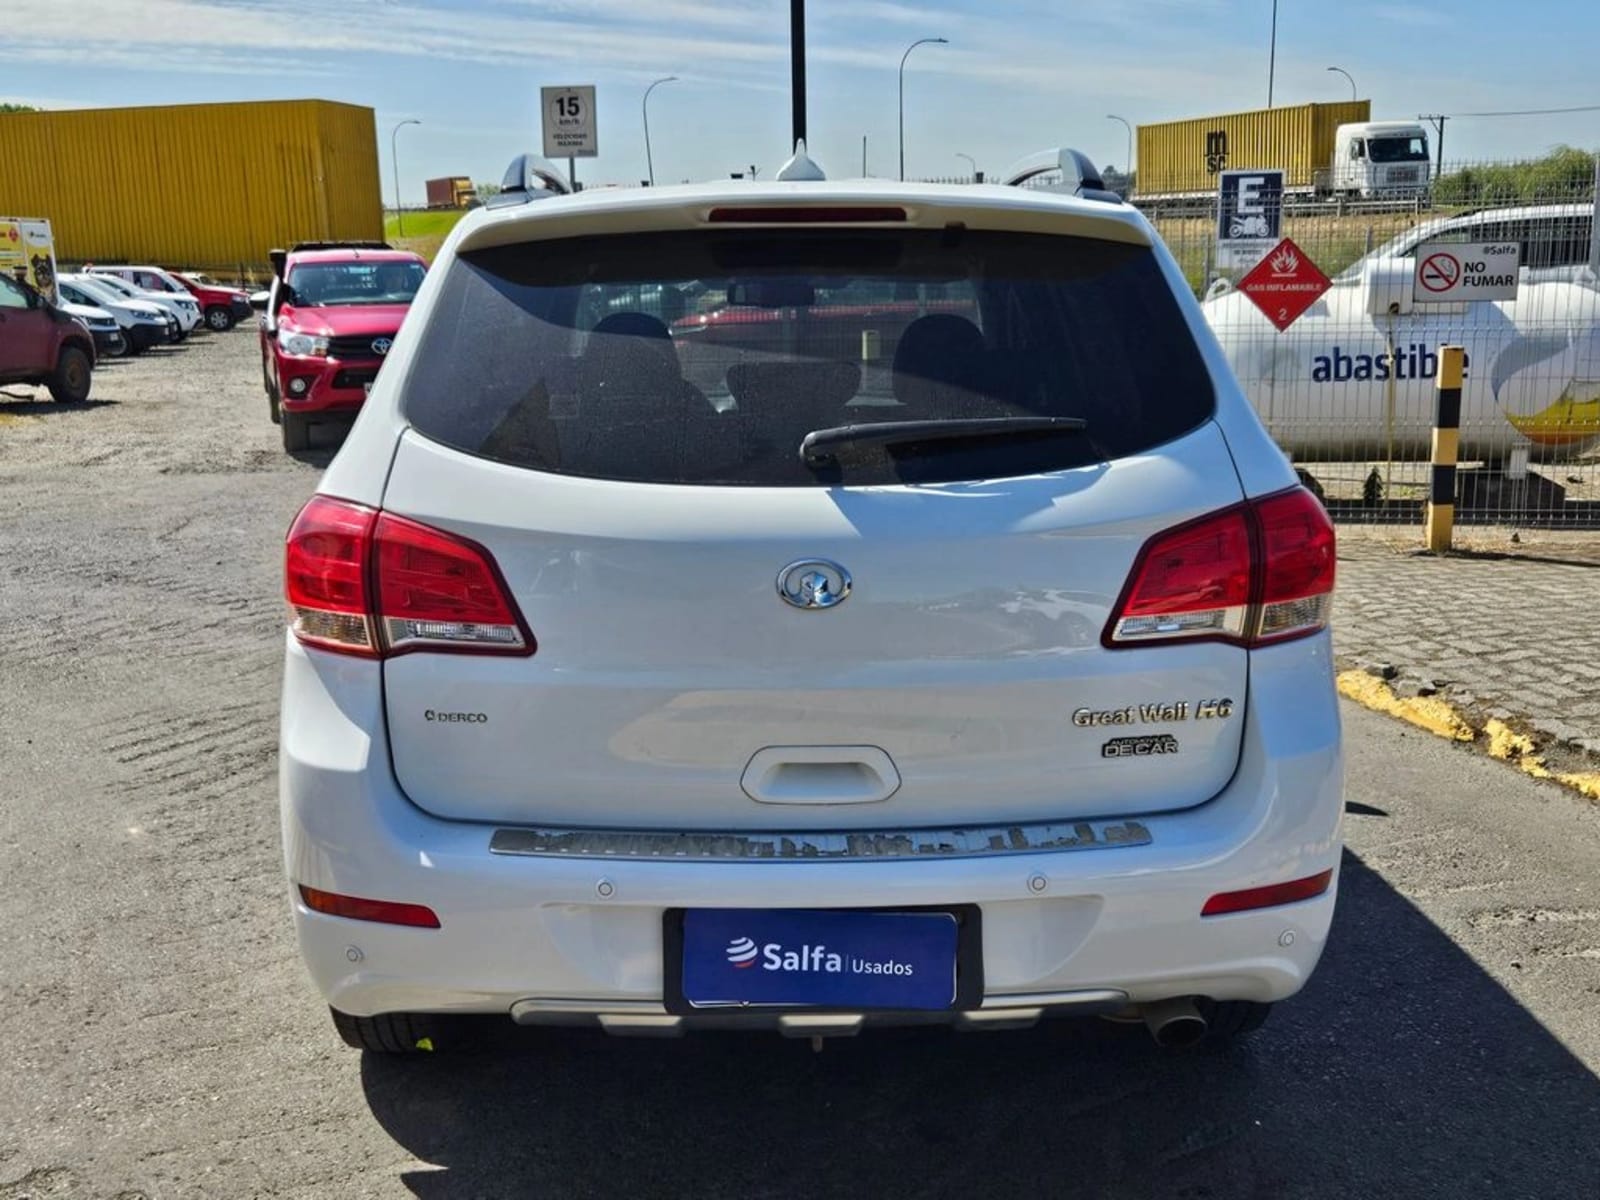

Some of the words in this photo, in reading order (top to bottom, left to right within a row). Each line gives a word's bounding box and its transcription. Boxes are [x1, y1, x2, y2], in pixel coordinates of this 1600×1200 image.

[555, 96, 580, 116] 15
[1238, 177, 1265, 214] E
[1464, 261, 1486, 273] NO
[1246, 283, 1265, 292] GAS
[1266, 282, 1323, 292] INFLAMABLE
[1463, 275, 1514, 287] FUMAR
[1278, 308, 1287, 321] 2
[438, 712, 488, 723] DERCO
[1072, 705, 1136, 727] Great
[1139, 702, 1190, 722] Wall
[1195, 698, 1233, 720] H6
[762, 943, 842, 972] Salfa
[852, 959, 913, 976] Usados
